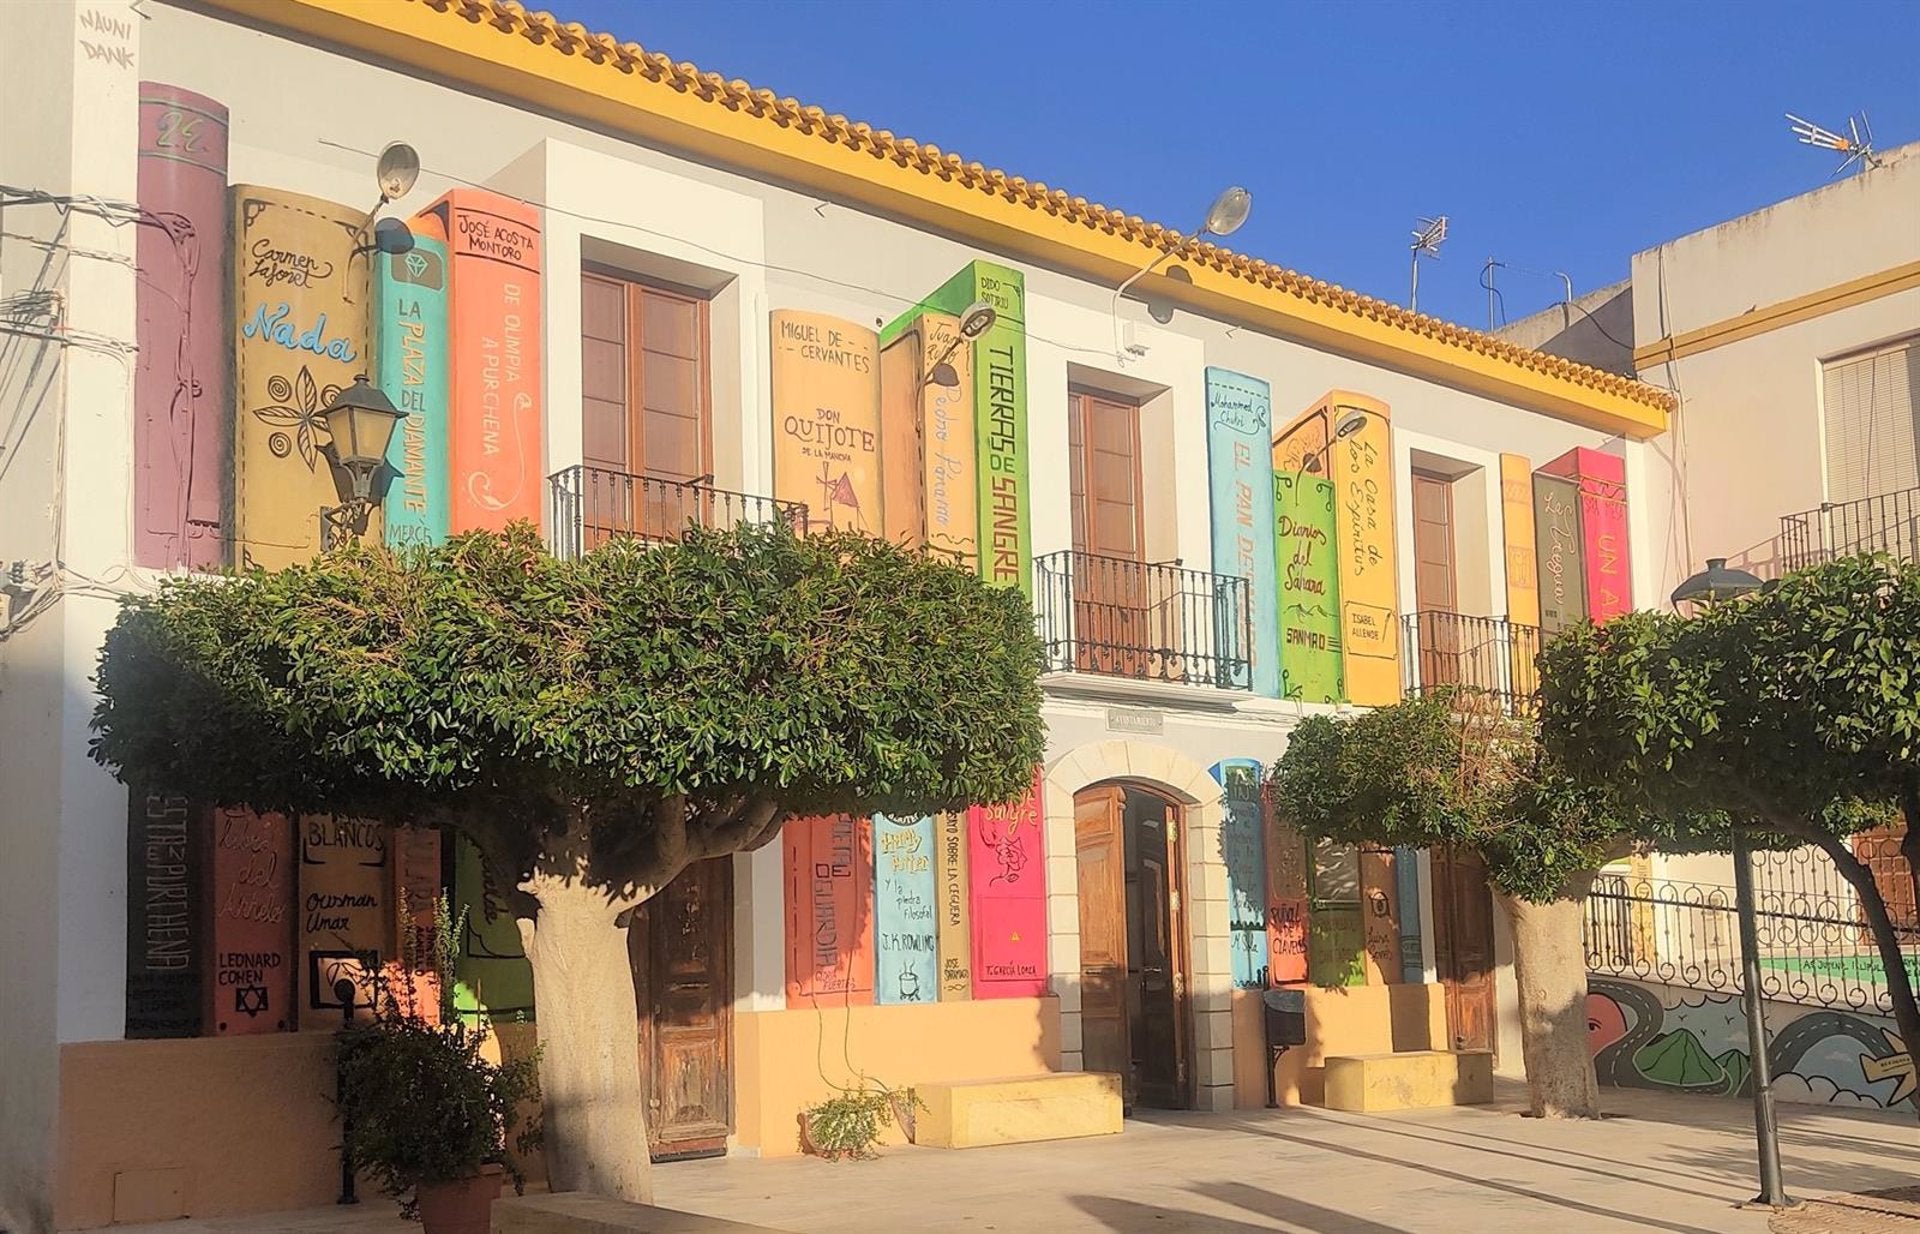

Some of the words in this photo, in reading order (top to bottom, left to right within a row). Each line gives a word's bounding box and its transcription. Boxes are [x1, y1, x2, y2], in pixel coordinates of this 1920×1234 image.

[79, 39, 135, 70] DANK
[457, 214, 490, 239] JOSÉ
[493, 225, 534, 250] ACOSTA
[468, 232, 522, 262] MONTORO
[252, 238, 319, 271] Carmen
[398, 297, 421, 321] LA
[503, 282, 522, 308] DE
[242, 302, 358, 364] Nada
[780, 320, 821, 344] MIGUEL
[828, 329, 843, 348] DE
[398, 320, 426, 386] PLAZA
[801, 344, 870, 374] CERVANTES
[401, 389, 426, 414] DEL
[482, 352, 501, 456] PURCHENA
[816, 407, 840, 424] DON
[988, 345, 1015, 456] TIERRAS
[784, 415, 875, 452] QUIJOTE
[402, 413, 428, 515] DIAMANTE
[802, 446, 812, 457] DE
[814, 448, 824, 458] LA
[825, 450, 852, 461] MANCHA
[989, 456, 1015, 475] DE
[1234, 440, 1252, 472] EL
[1235, 479, 1254, 528] PAN
[991, 476, 1019, 583] SANGRE
[1278, 515, 1327, 546] Diarios
[1293, 540, 1312, 566] del
[308, 822, 385, 852] BLANCOS
[946, 836, 960, 866] SOBRE
[947, 868, 958, 881] LA
[144, 863, 190, 970] PURCHENA
[947, 883, 961, 927] CEGUERA
[218, 952, 281, 969] LEONARD
[217, 968, 263, 985] COHEN
